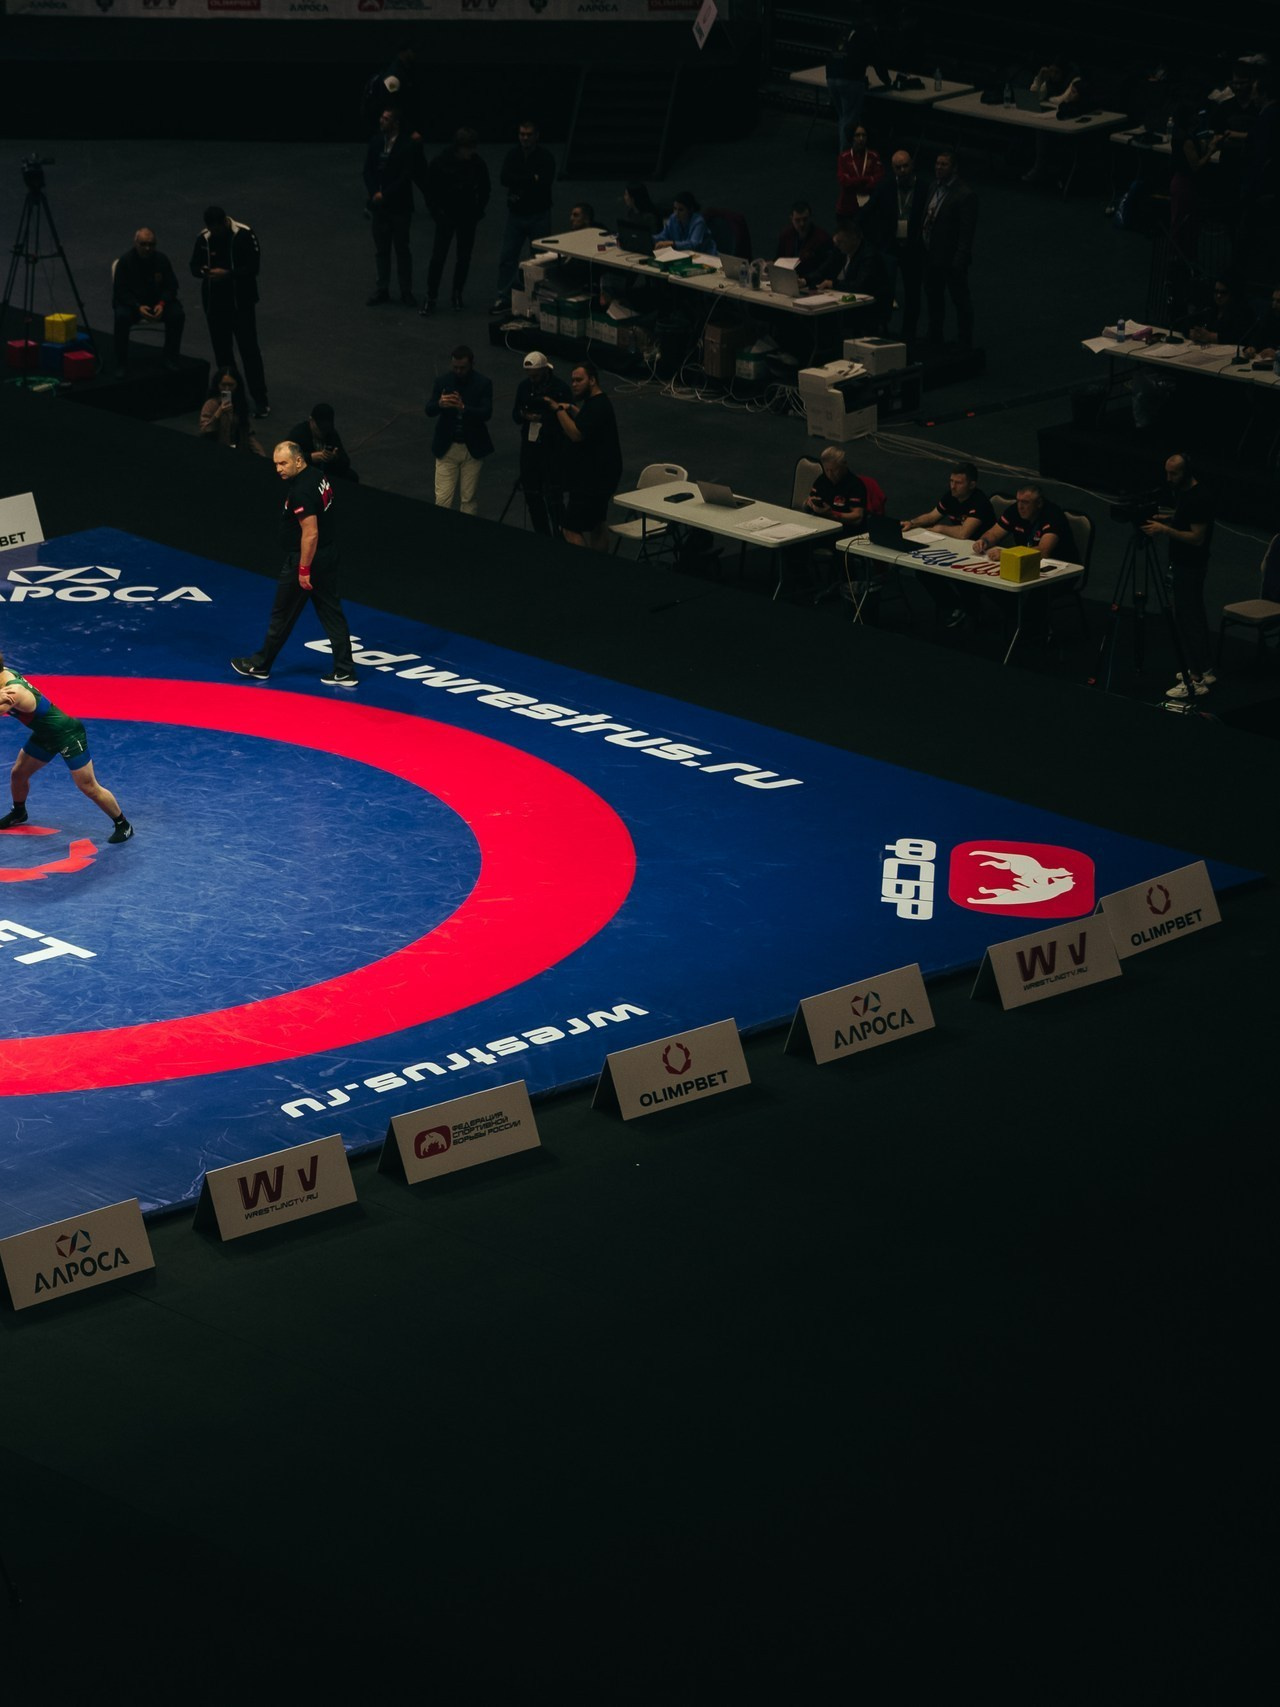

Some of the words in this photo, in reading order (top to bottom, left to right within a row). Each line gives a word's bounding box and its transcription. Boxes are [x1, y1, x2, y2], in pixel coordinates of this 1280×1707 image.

[1131, 908, 1202, 946] OLIMPBET
[280, 1003, 650, 1119] wrestrus.ru
[639, 1069, 728, 1107] OLIMPBET
[451, 1111, 503, 1132] ФЕДЕРАЦИЯ
[452, 1115, 509, 1138] СПОРТИВНОЙ
[453, 1130, 486, 1146] БОРЬБЫ
[487, 1119, 521, 1136] РОССИИ
[244, 1192, 319, 1220] WRESTLINGTV.RU
